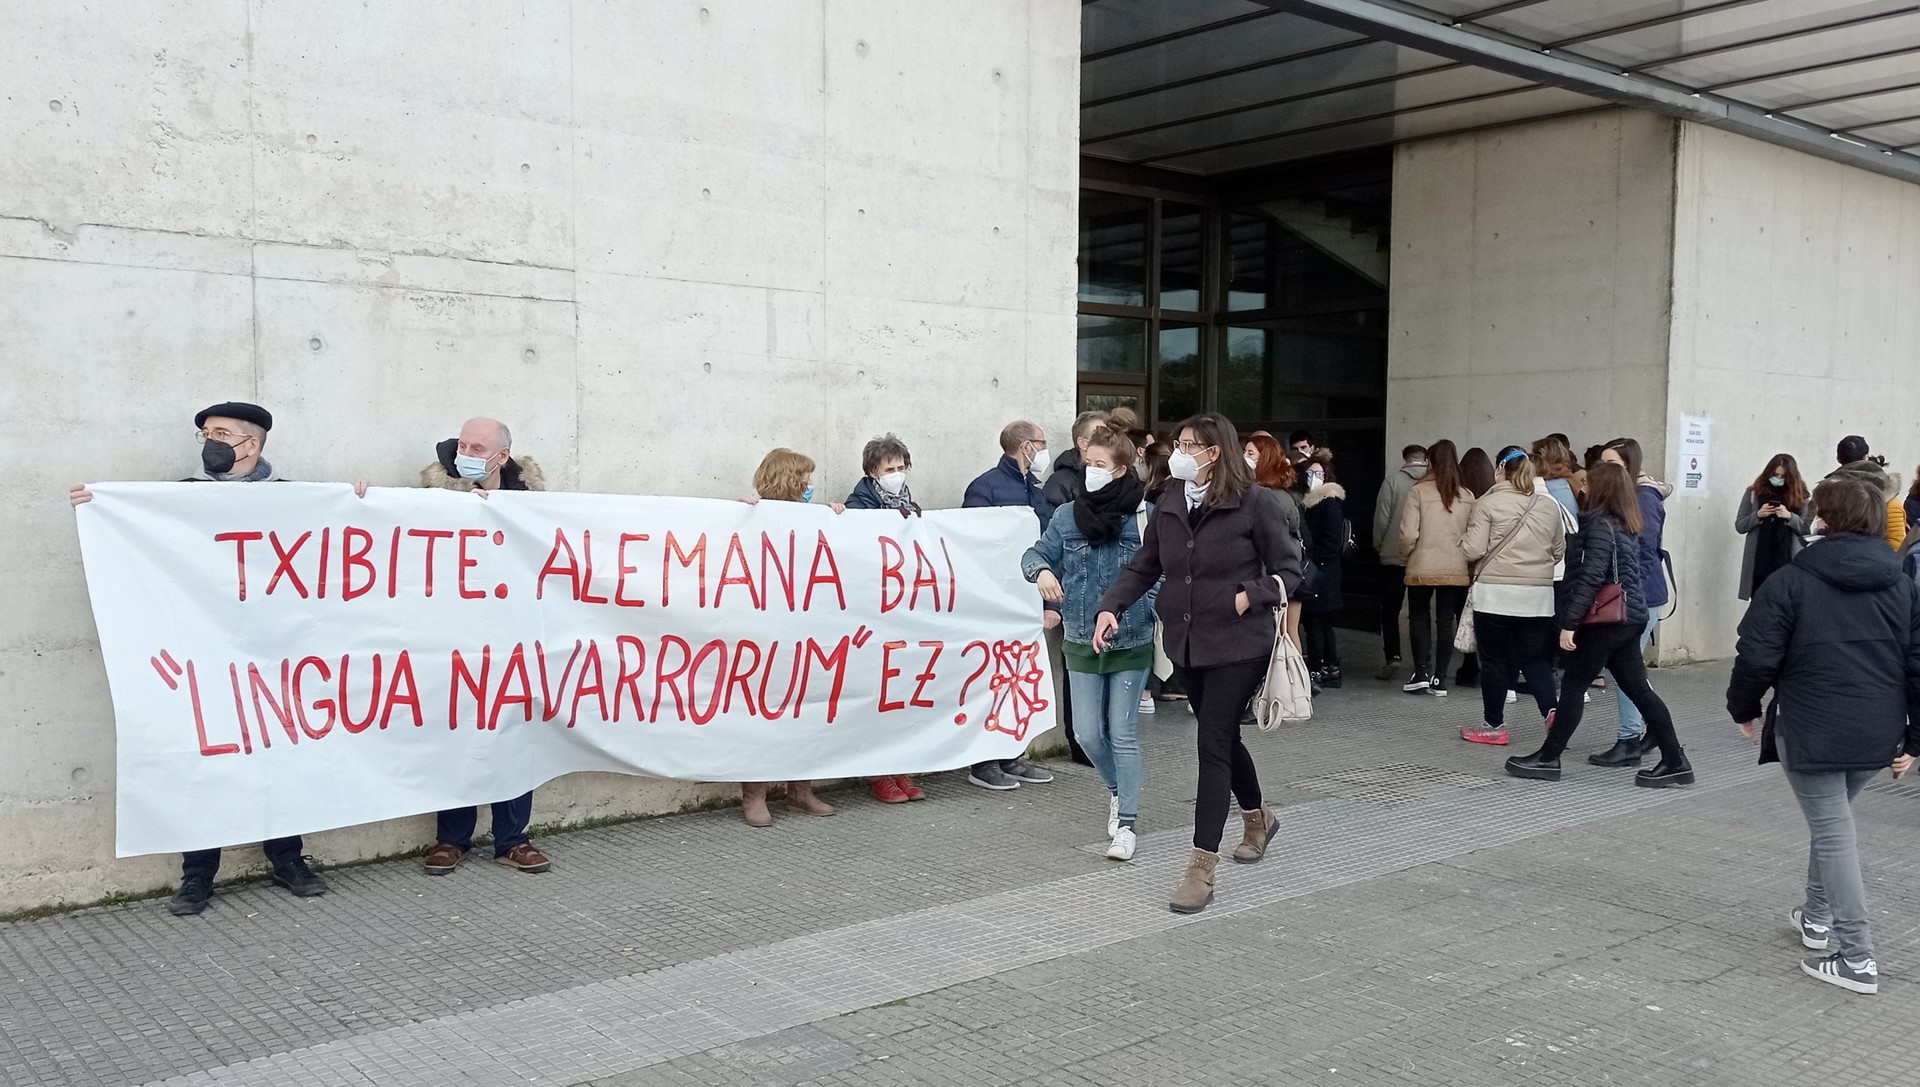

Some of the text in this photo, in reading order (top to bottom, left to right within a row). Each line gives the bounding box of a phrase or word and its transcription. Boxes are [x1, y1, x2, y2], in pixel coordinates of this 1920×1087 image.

[214, 526, 957, 614] TXIBITE: ALEMANA BAI
[151, 649, 424, 757] "LINGUA
[449, 625, 873, 731] NAVARRORUM"
